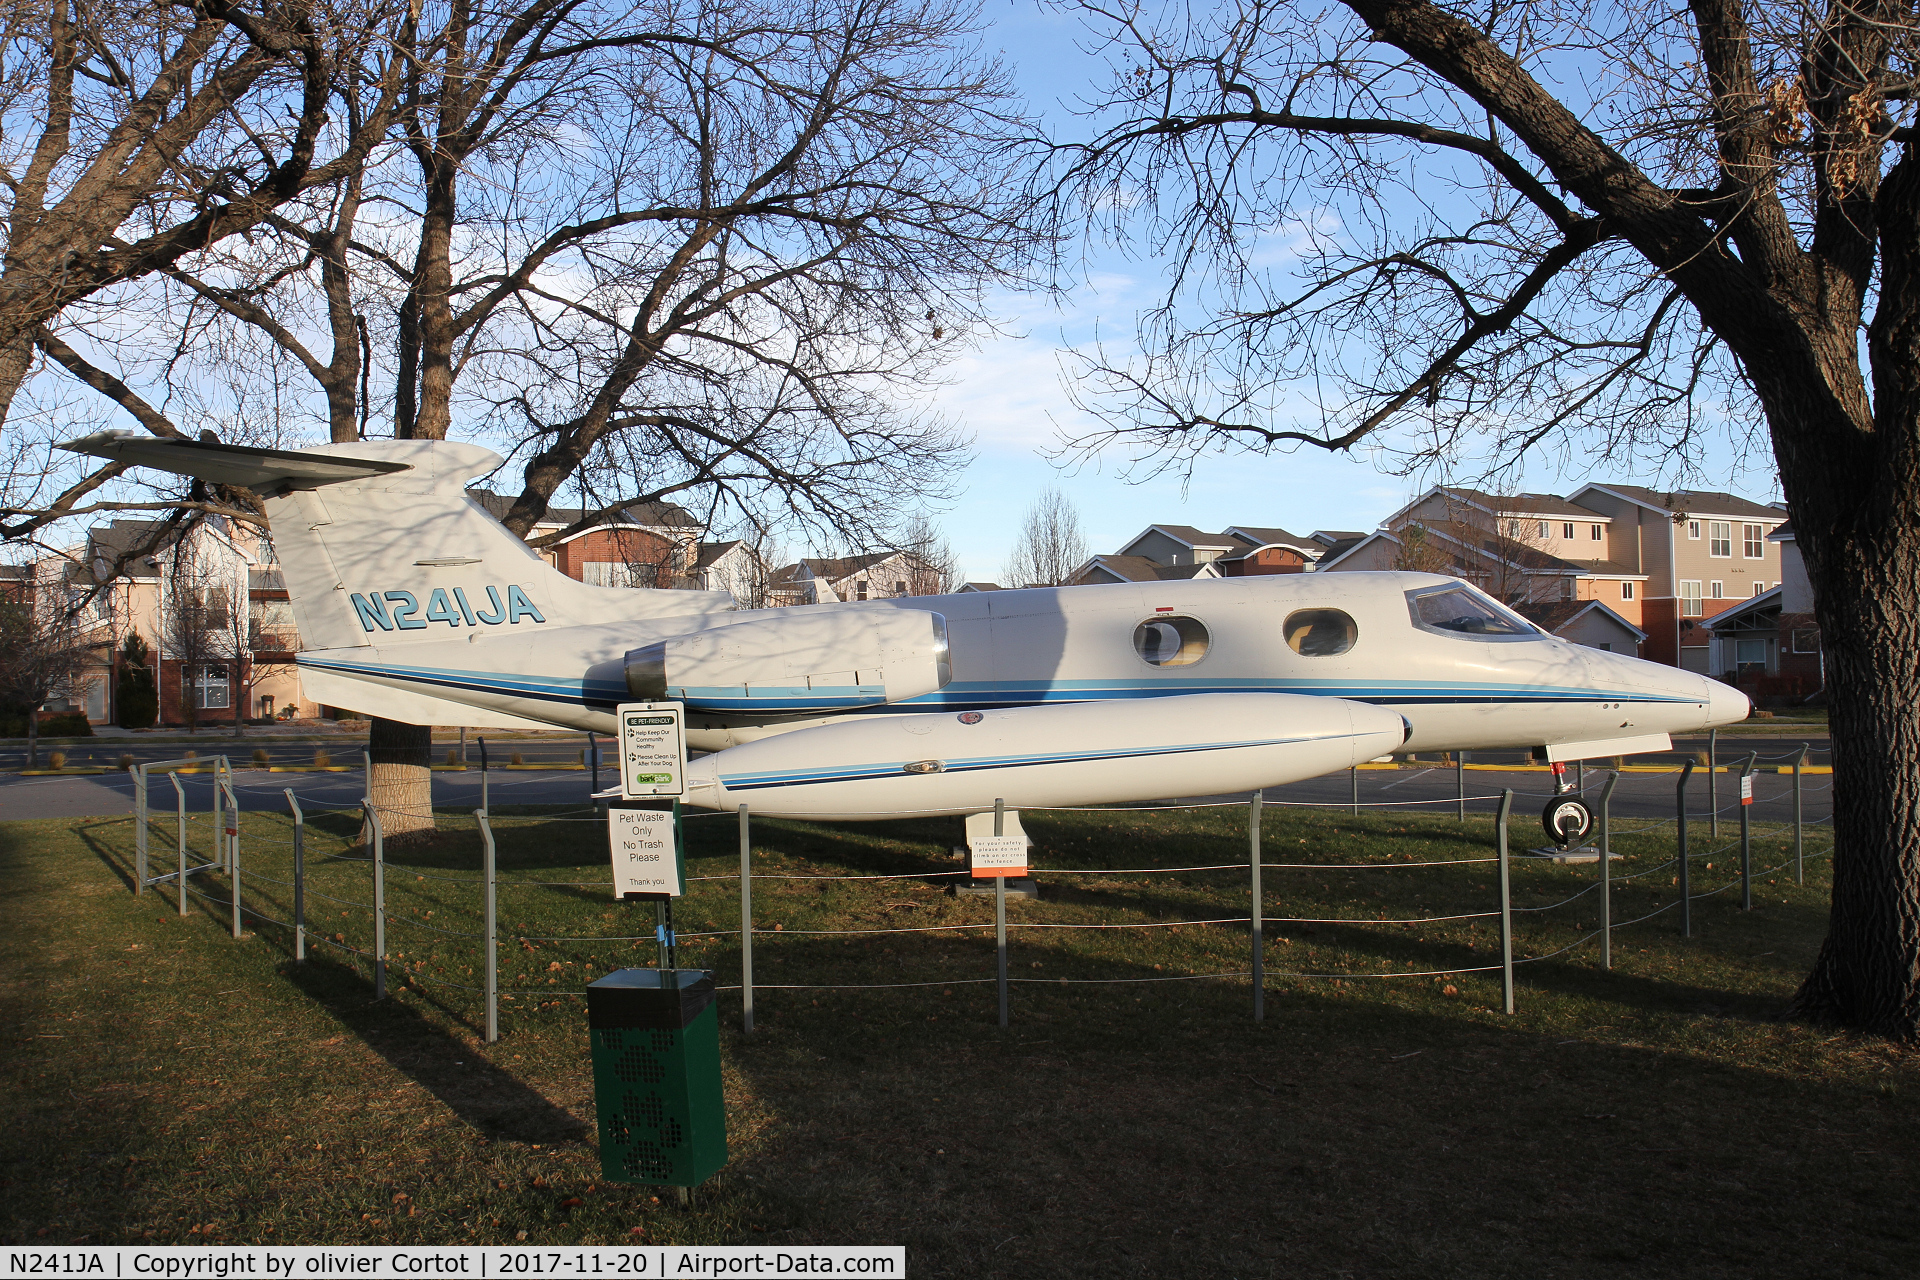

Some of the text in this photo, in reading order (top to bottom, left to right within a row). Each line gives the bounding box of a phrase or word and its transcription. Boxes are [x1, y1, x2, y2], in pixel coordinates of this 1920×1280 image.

[638, 717, 671, 725] PET-FRIENDLY
[619, 813, 664, 823] Pet Waste
[632, 826, 652, 837] Only
[623, 840, 664, 850] No Trash
[629, 853, 660, 862] Please
[629, 878, 665, 886] Thank you
